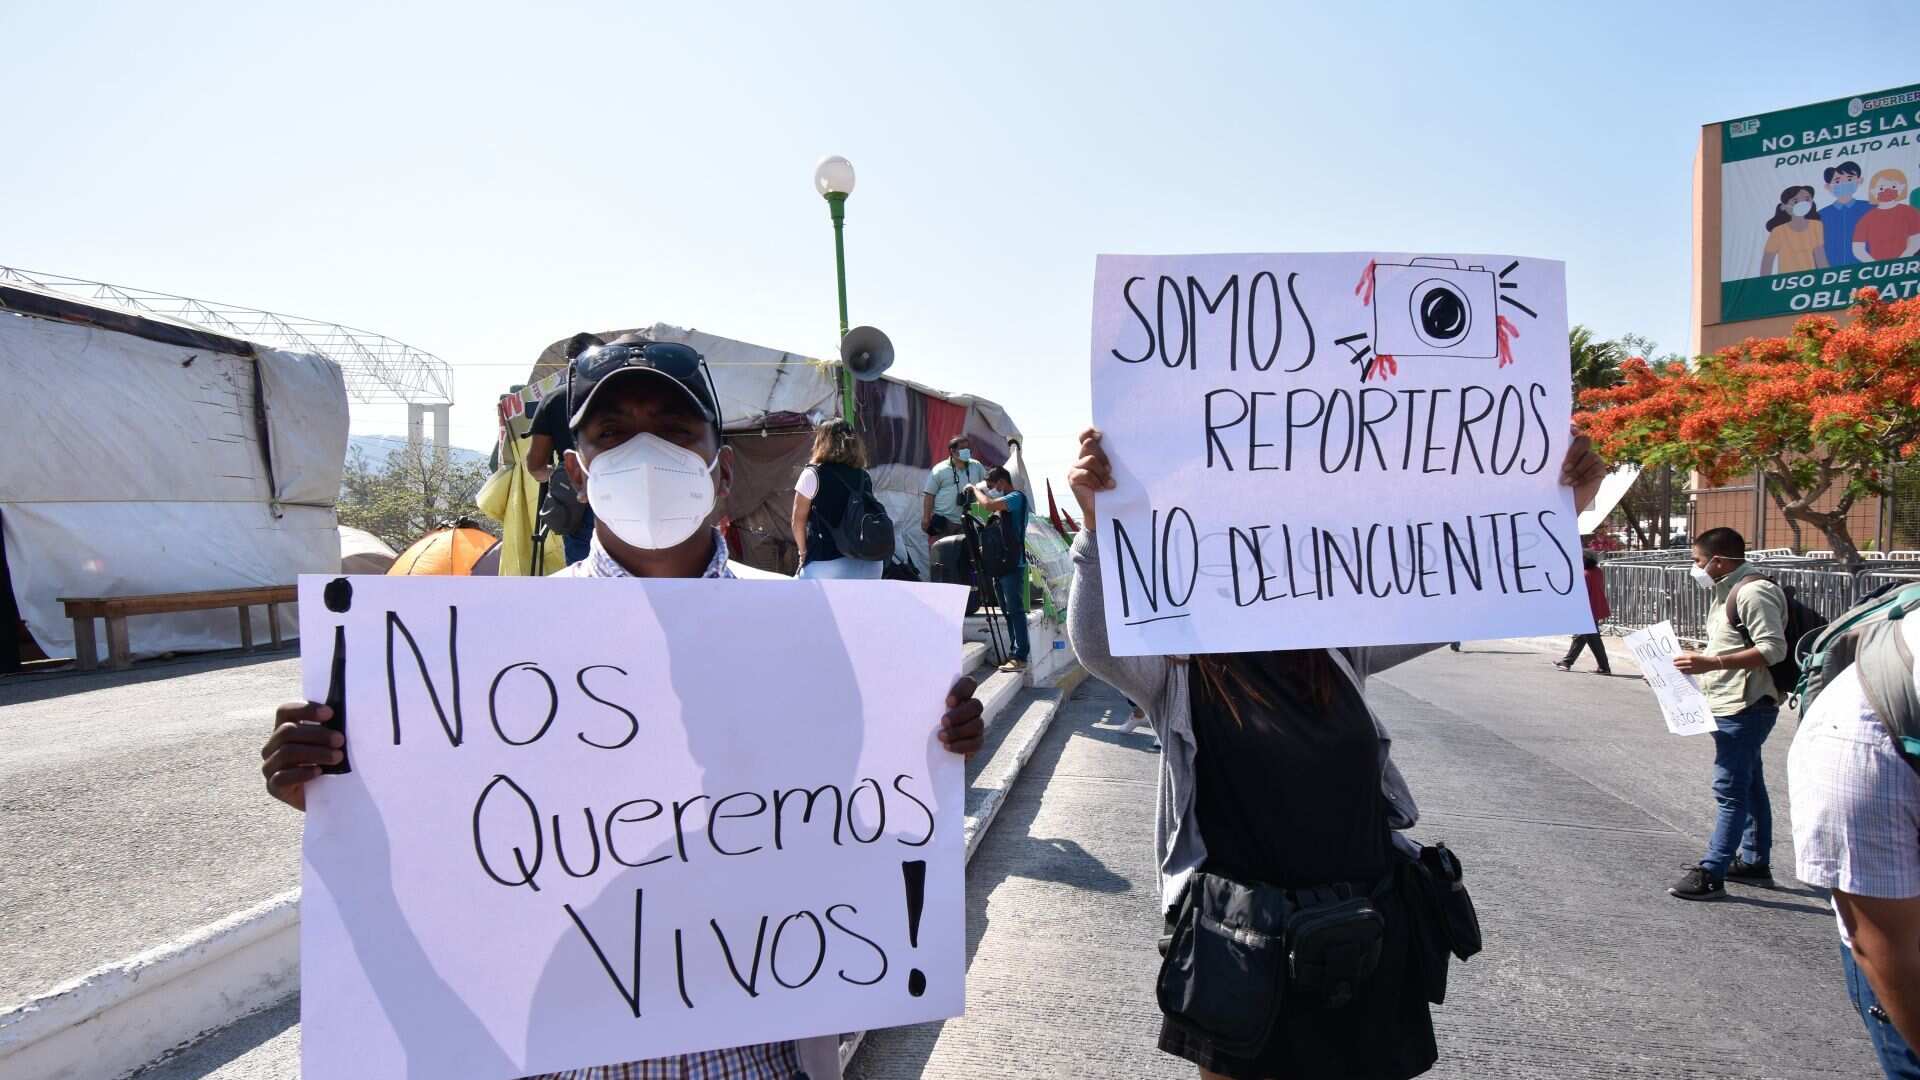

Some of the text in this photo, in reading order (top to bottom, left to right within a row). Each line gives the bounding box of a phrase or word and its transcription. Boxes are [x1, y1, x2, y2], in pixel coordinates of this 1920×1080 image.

[1762, 134, 1795, 152] NO
[1803, 120, 1872, 145] BAJES
[1879, 114, 1908, 131] LA
[1775, 135, 1910, 168] PONLE ALTO AL
[1771, 274, 1816, 291] USO
[1821, 269, 1852, 286] DE
[1789, 280, 1920, 311] OBLIAT
[1112, 271, 1316, 373] SOMOS
[1204, 382, 1550, 476] REPORTEROS
[1112, 506, 1575, 618] NO DELINCUENTES
[472, 773, 936, 892] Queremos
